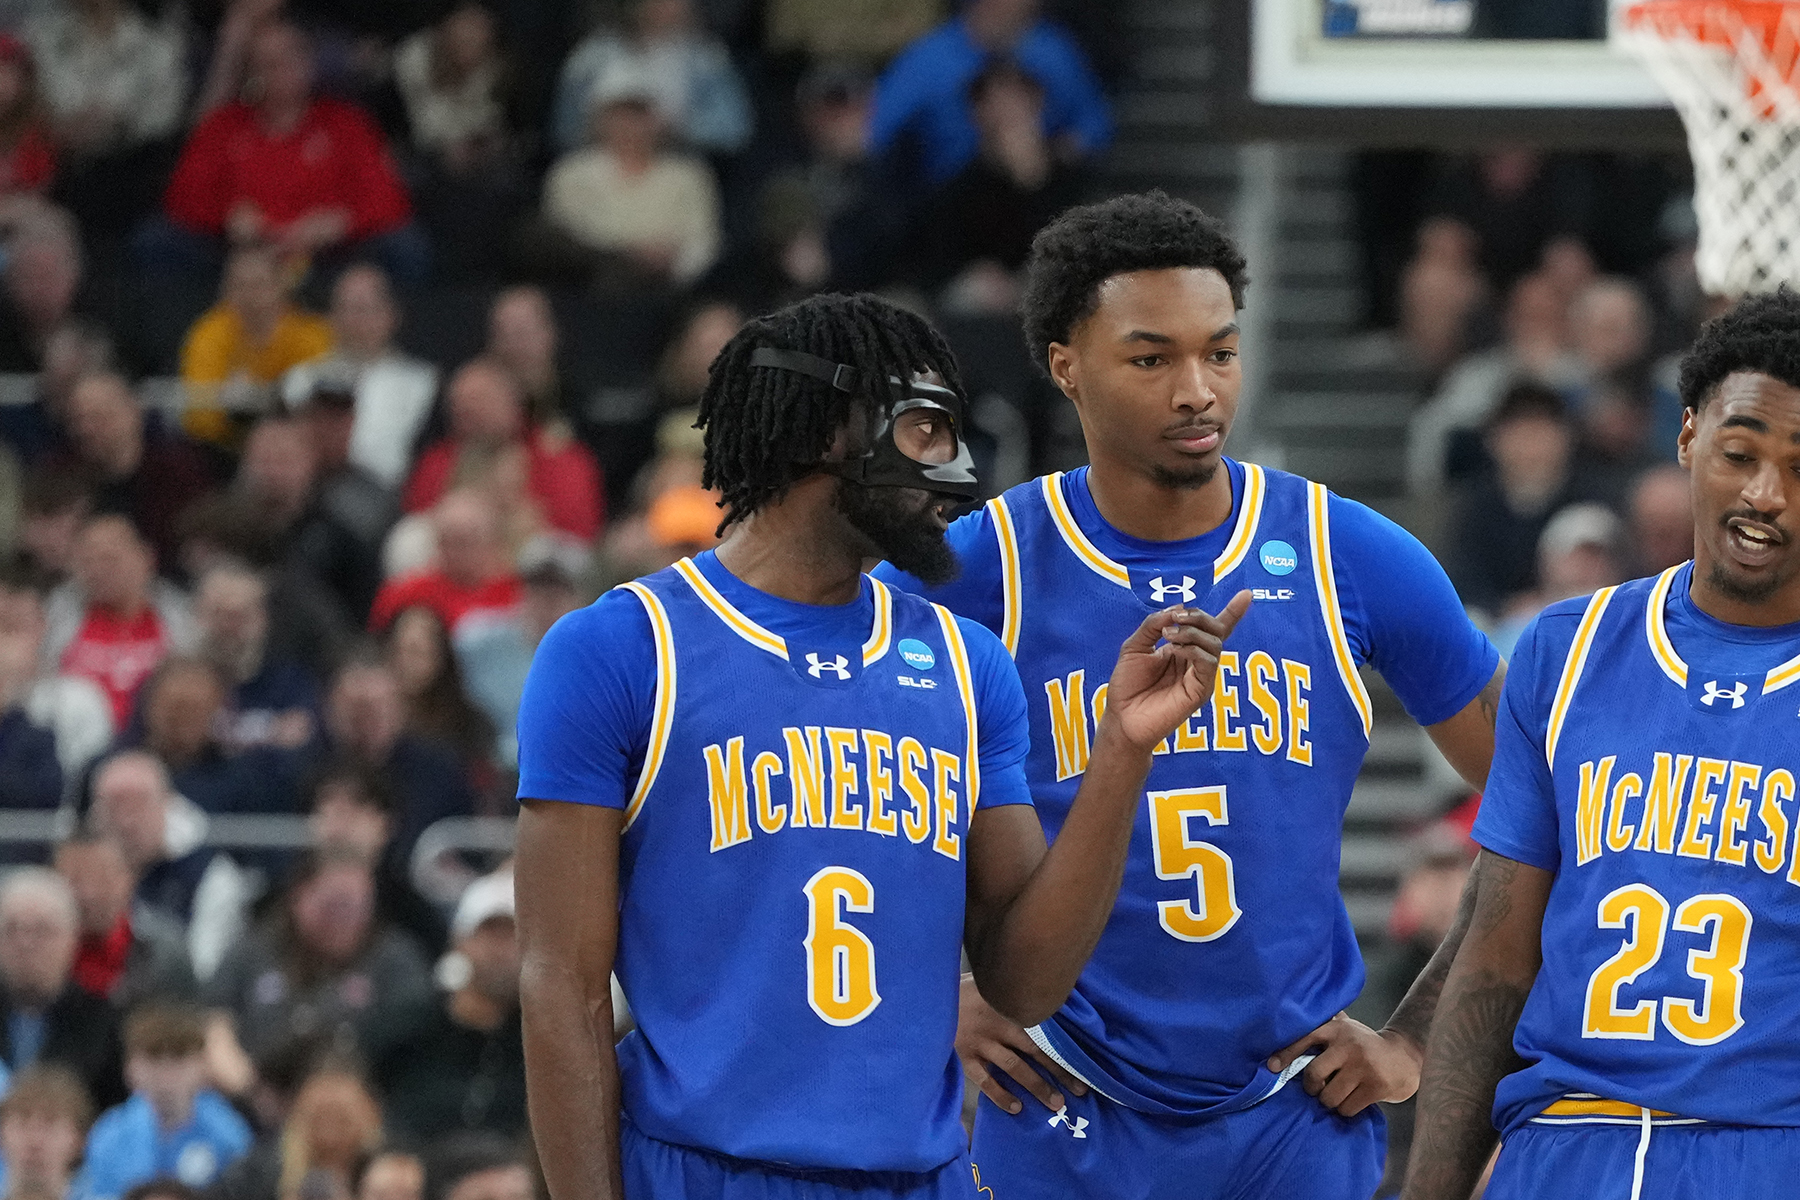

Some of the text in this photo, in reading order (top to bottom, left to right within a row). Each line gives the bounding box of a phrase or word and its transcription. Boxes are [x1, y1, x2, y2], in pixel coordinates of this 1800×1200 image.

[1252, 589, 1296, 600] SLC
[1264, 555, 1295, 568] NCAA
[896, 675, 938, 689] SLC
[903, 651, 934, 663] NCAA
[1044, 650, 1313, 782] MESE
[702, 726, 962, 862] McNEESE
[1147, 785, 1243, 943] 5
[802, 866, 883, 1027] 6
[1582, 883, 1753, 1047] 23
